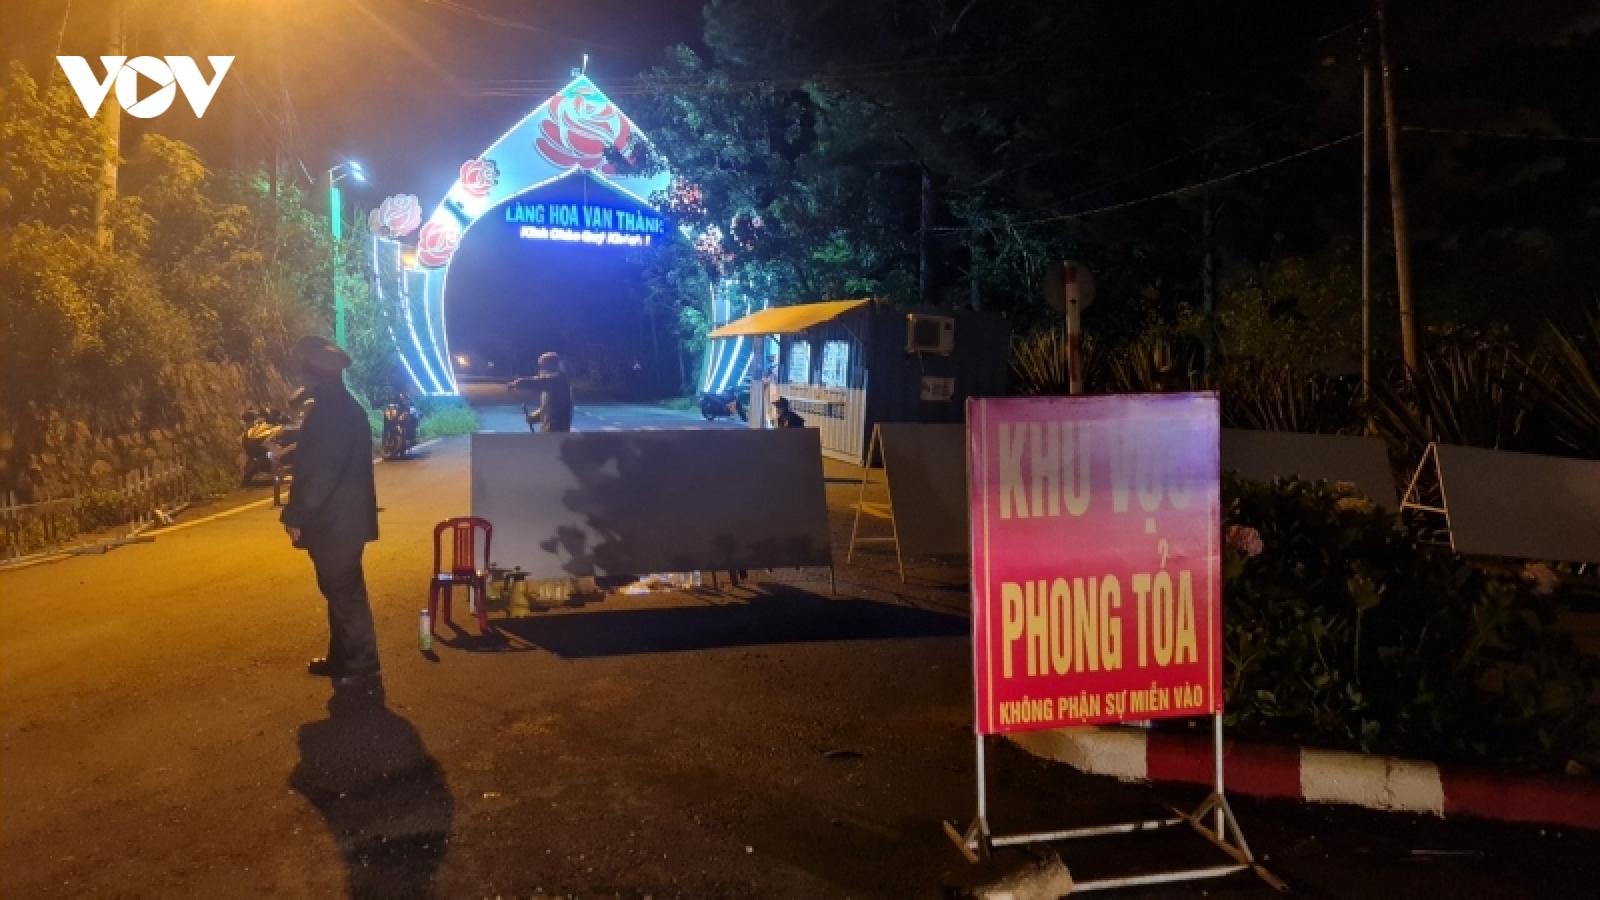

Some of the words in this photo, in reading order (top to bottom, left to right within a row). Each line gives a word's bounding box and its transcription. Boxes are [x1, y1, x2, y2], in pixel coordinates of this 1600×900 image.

[505, 201, 544, 223] LÀNG
[550, 203, 579, 226] HOA
[999, 421, 1090, 519] KHU
[1001, 574, 1122, 679] PHONG
[1132, 538, 1198, 668] TỎA
[1000, 695, 1053, 725] KHÔNG
[1058, 690, 1101, 723] PHẬN
[1105, 689, 1127, 720] SỰ
[1174, 681, 1203, 709] VÀO
